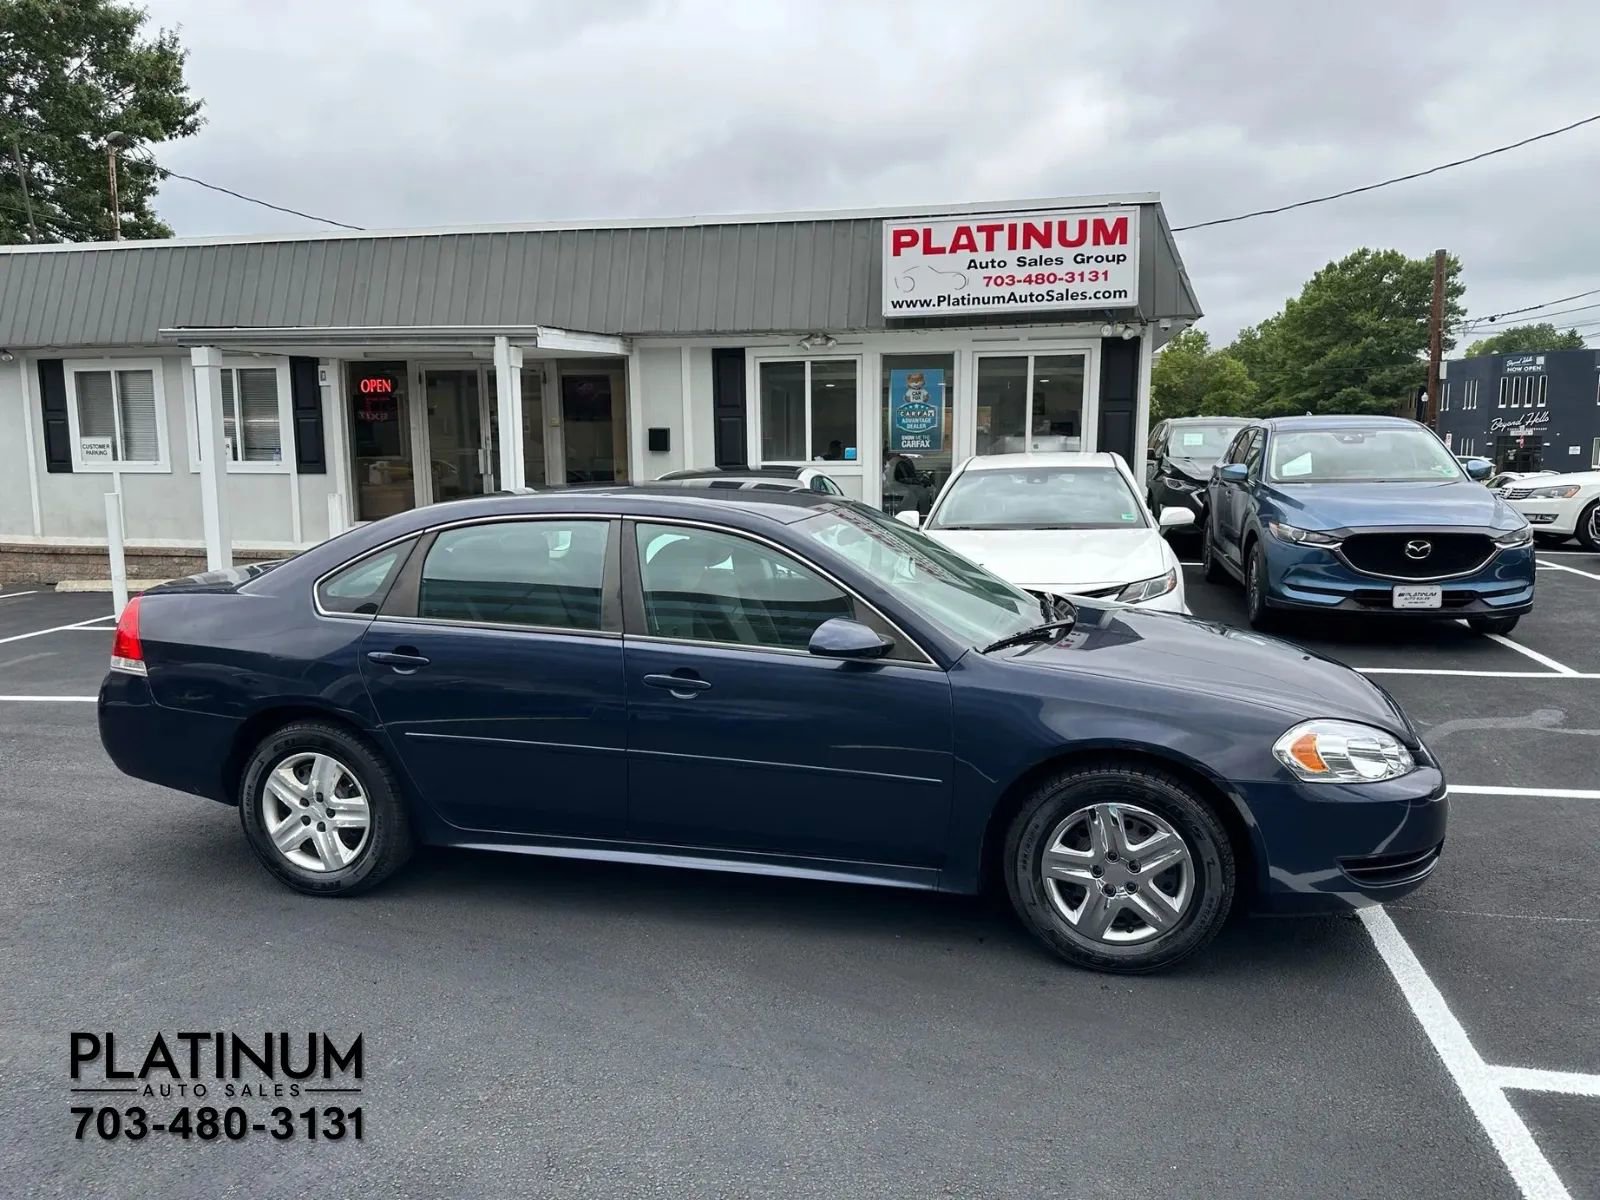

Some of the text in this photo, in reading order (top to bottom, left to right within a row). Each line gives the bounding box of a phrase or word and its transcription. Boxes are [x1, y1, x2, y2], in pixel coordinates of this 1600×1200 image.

[892, 217, 1128, 256] PLATINUM
[967, 252, 1127, 270] Auto Sales Group
[983, 270, 1109, 287] 703-480-3131
[892, 289, 1127, 308] www.PlatinumAutoSales.com
[360, 379, 392, 393] OPEN
[1490, 411, 1550, 432] Beyond Hello
[901, 440, 930, 448] CARFAX
